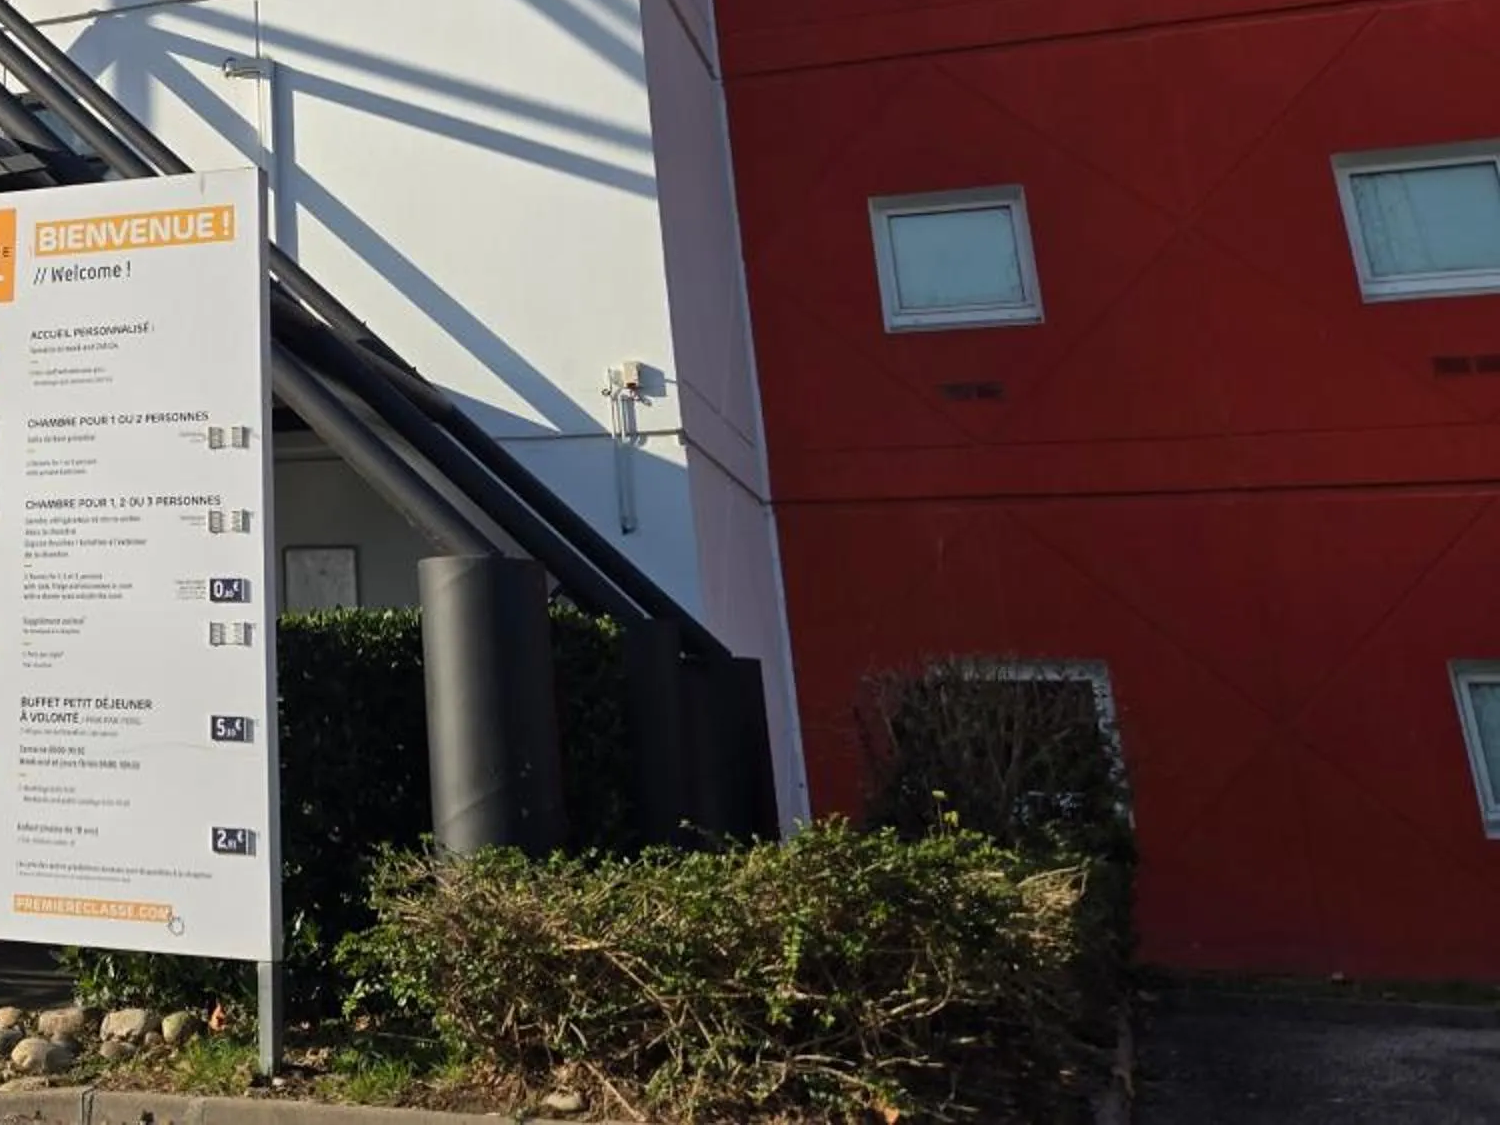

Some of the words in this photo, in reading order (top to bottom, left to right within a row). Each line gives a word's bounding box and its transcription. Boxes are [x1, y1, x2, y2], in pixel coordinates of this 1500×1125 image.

[38, 211, 215, 252] BIENVENUE
[51, 264, 122, 283] Welcome
[30, 329, 72, 340] ACCUEIL
[27, 418, 77, 428] CHAMBRE
[80, 416, 107, 426] POUR
[117, 415, 134, 425] OU
[135, 414, 143, 424] 2
[145, 411, 209, 424] PERSONNES
[25, 499, 76, 510] CHAMBRE
[79, 498, 107, 508] POUR
[119, 497, 126, 507] 2
[129, 497, 145, 507] OU
[155, 495, 221, 507] PERSONNES
[20, 696, 60, 709] BUFFET
[63, 697, 92, 709] PETIT
[95, 696, 153, 710] DÉJEUNER
[16, 898, 171, 921] PREMIERECLASSE.COM
